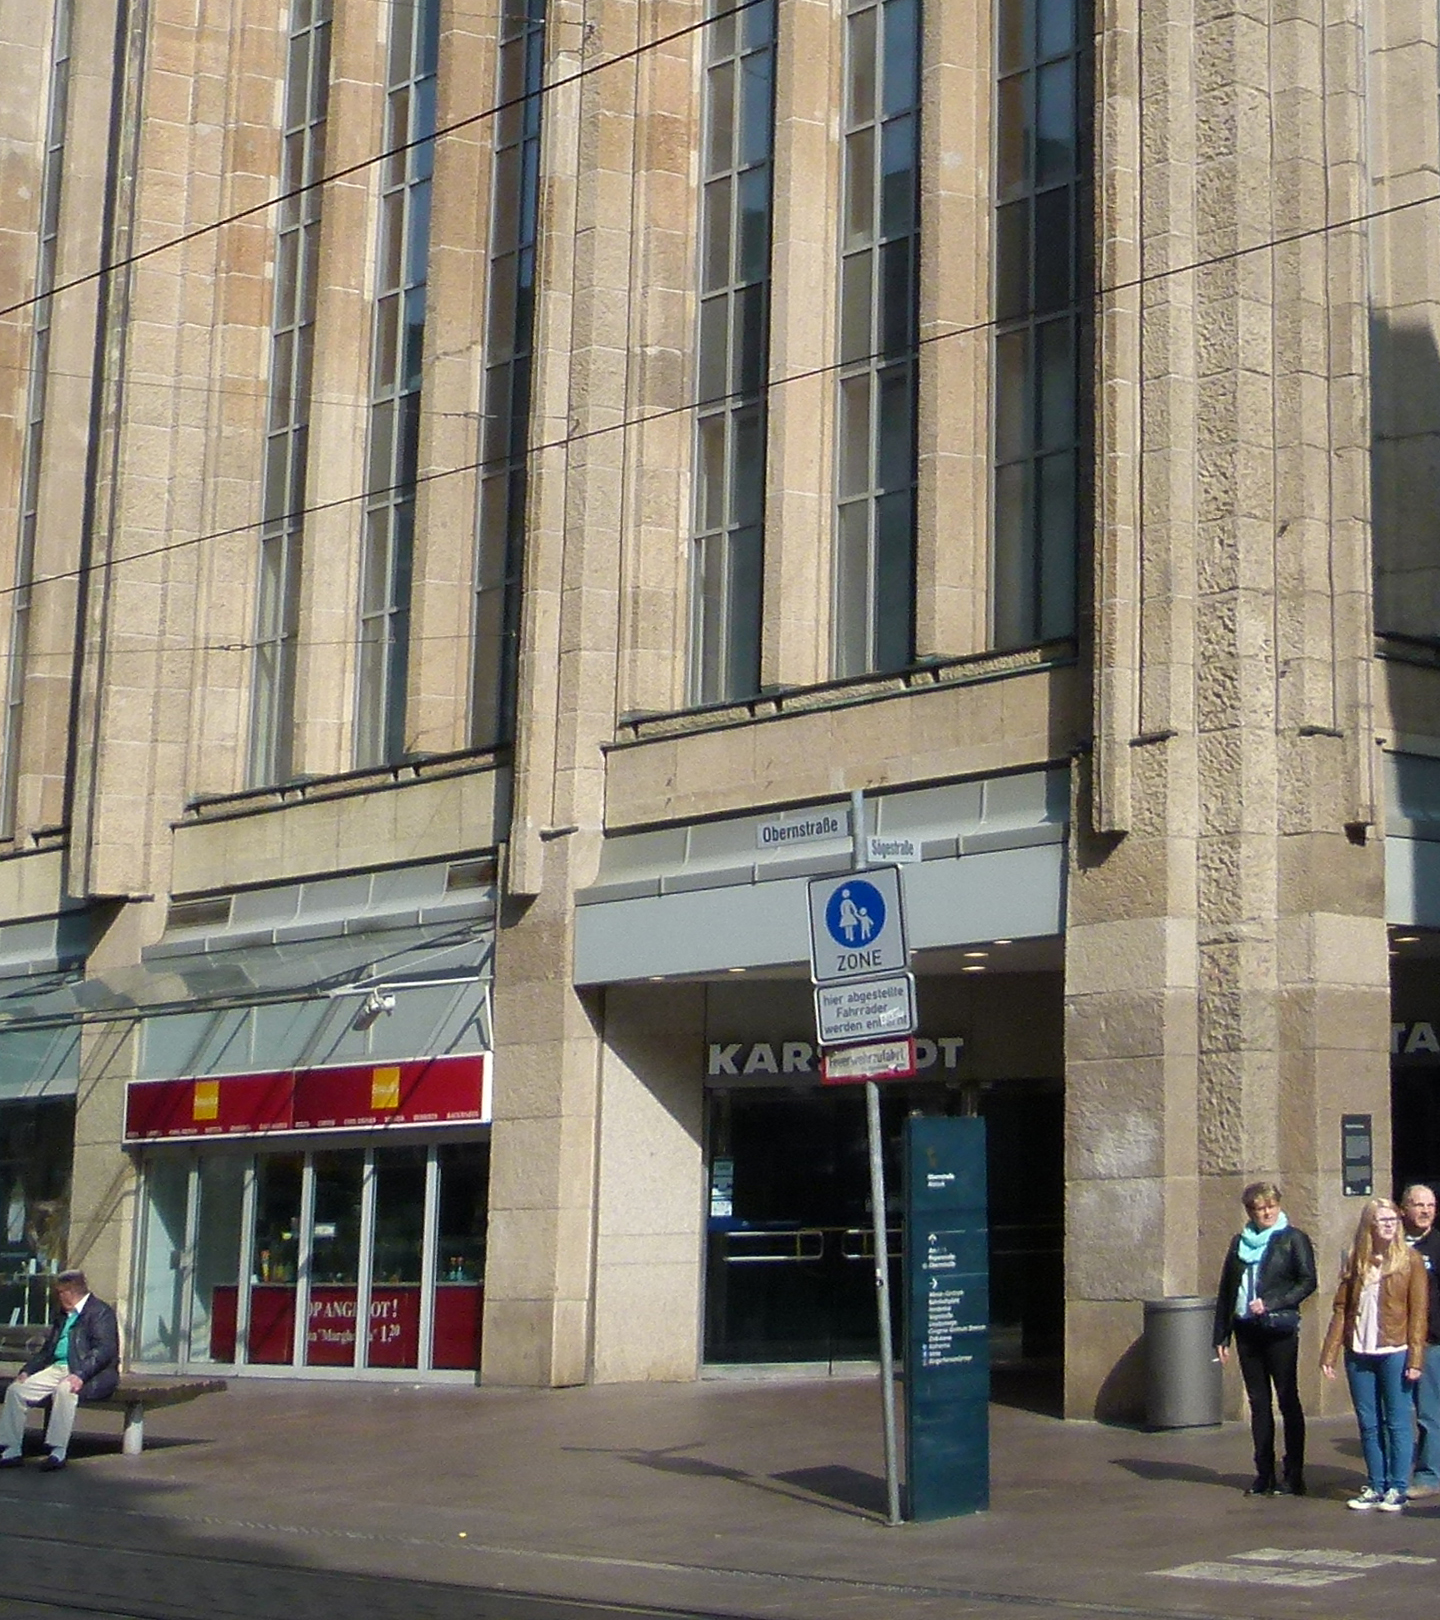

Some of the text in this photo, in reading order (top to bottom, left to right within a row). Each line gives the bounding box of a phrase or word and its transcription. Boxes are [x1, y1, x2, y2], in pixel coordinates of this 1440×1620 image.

[762, 817, 839, 843] Obernstraße
[871, 839, 915, 860] Sögestraße
[836, 949, 882, 972] ZONE
[823, 986, 904, 1007] hier abgestellte
[836, 1003, 888, 1018] Fahrräder
[824, 1015, 908, 1035] werden enternt
